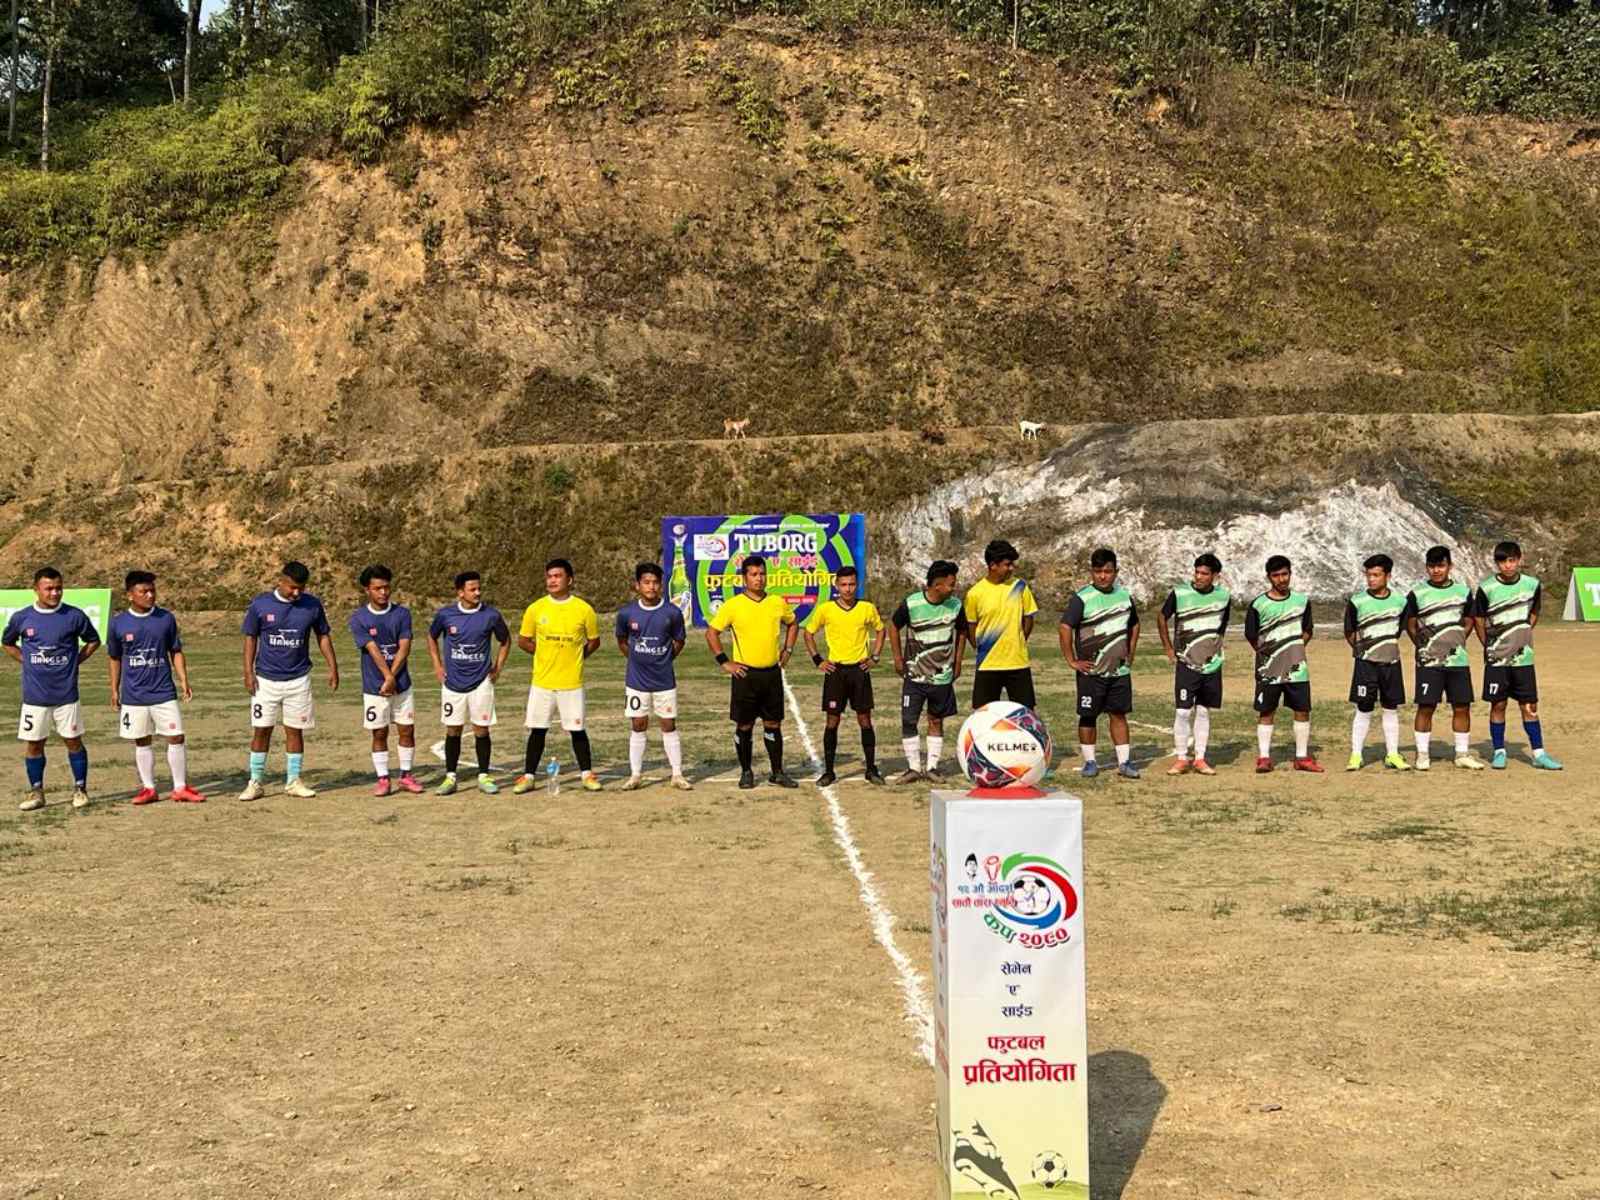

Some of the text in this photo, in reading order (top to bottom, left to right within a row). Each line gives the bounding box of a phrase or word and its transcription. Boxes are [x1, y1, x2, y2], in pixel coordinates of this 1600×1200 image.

[734, 533, 818, 553] TUBORG
[704, 570, 838, 592] फुटब प्रतियोगि
[1357, 685, 1367, 697] 10
[1422, 683, 1429, 695] 7
[1490, 683, 1499, 695] 17
[1081, 696, 1093, 708] 22
[1257, 692, 1263, 704] 4
[253, 704, 263, 719] 8
[366, 706, 377, 722] 6
[444, 702, 454, 718] 9
[23, 714, 34, 731] 5
[122, 713, 131, 730] 4
[988, 743, 1030, 752] KELME
[987, 1035, 1046, 1054] फुटबल
[962, 1058, 1078, 1086] प्रतियोगिता
